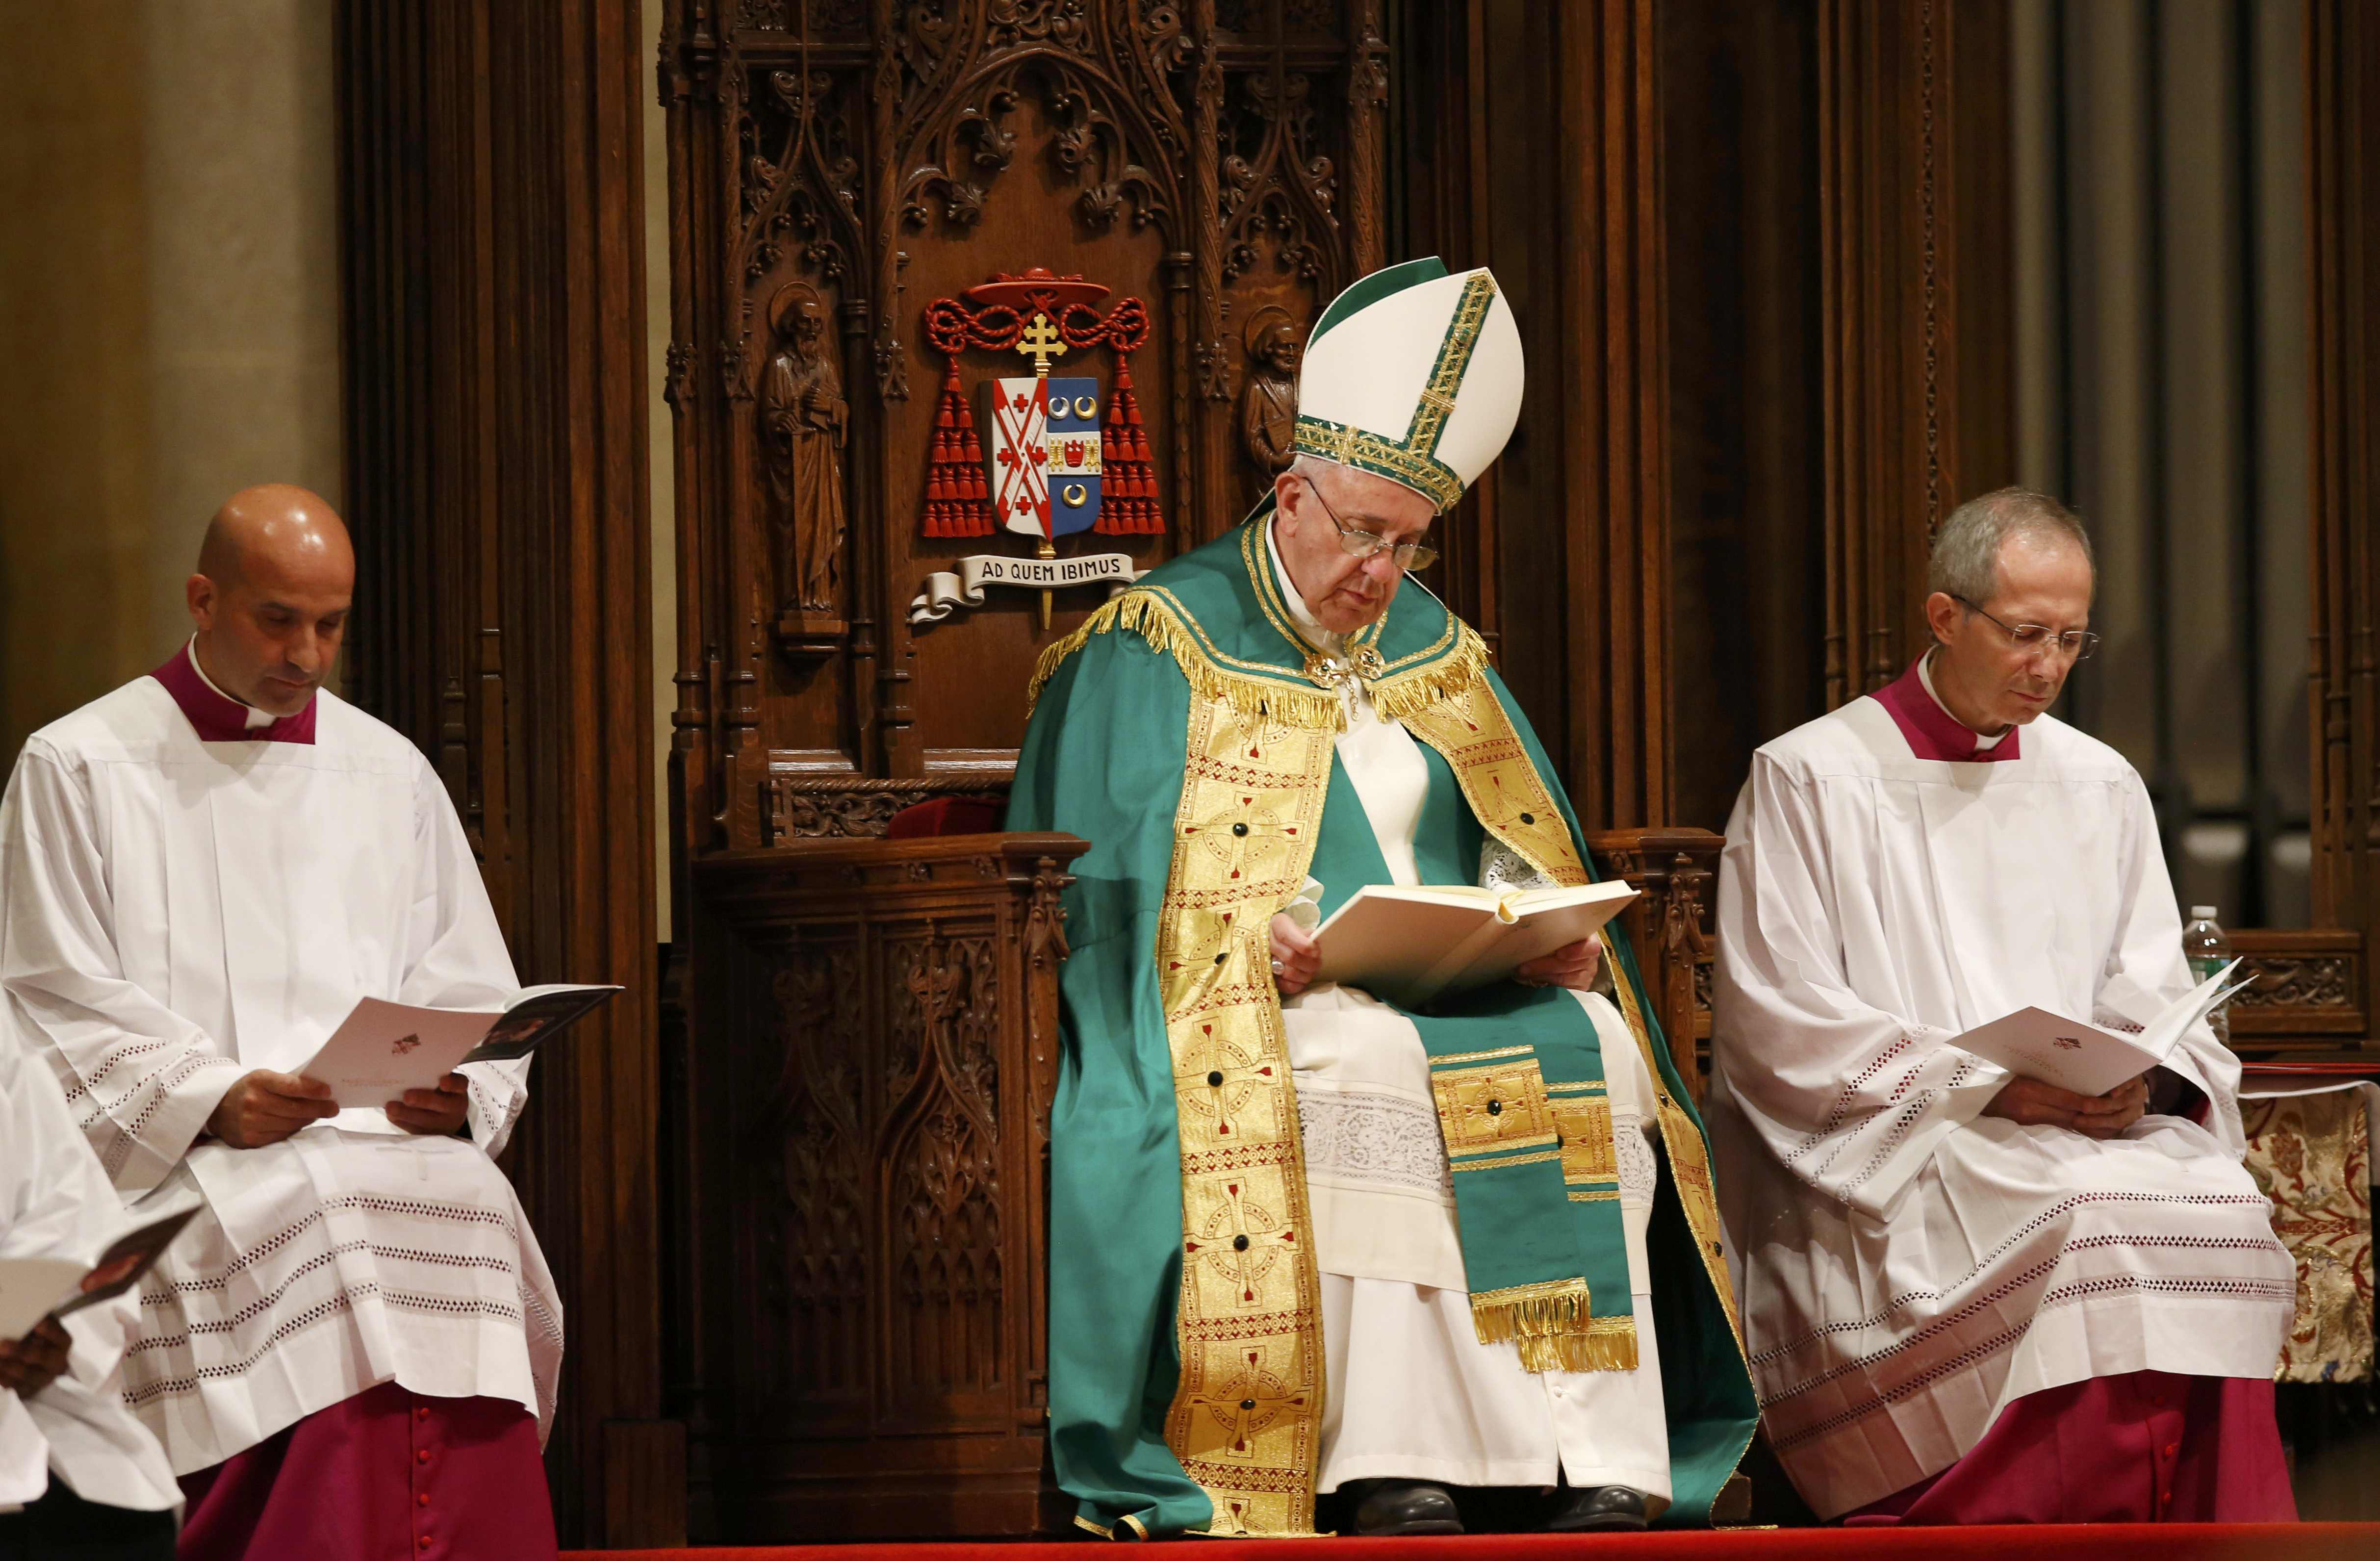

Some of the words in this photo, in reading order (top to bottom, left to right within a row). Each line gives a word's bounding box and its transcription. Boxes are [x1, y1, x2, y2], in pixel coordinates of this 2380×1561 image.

[982, 562, 1003, 578] AD
[1011, 563, 1054, 581] QUEM
[1061, 559, 1121, 580] IBIMUS
